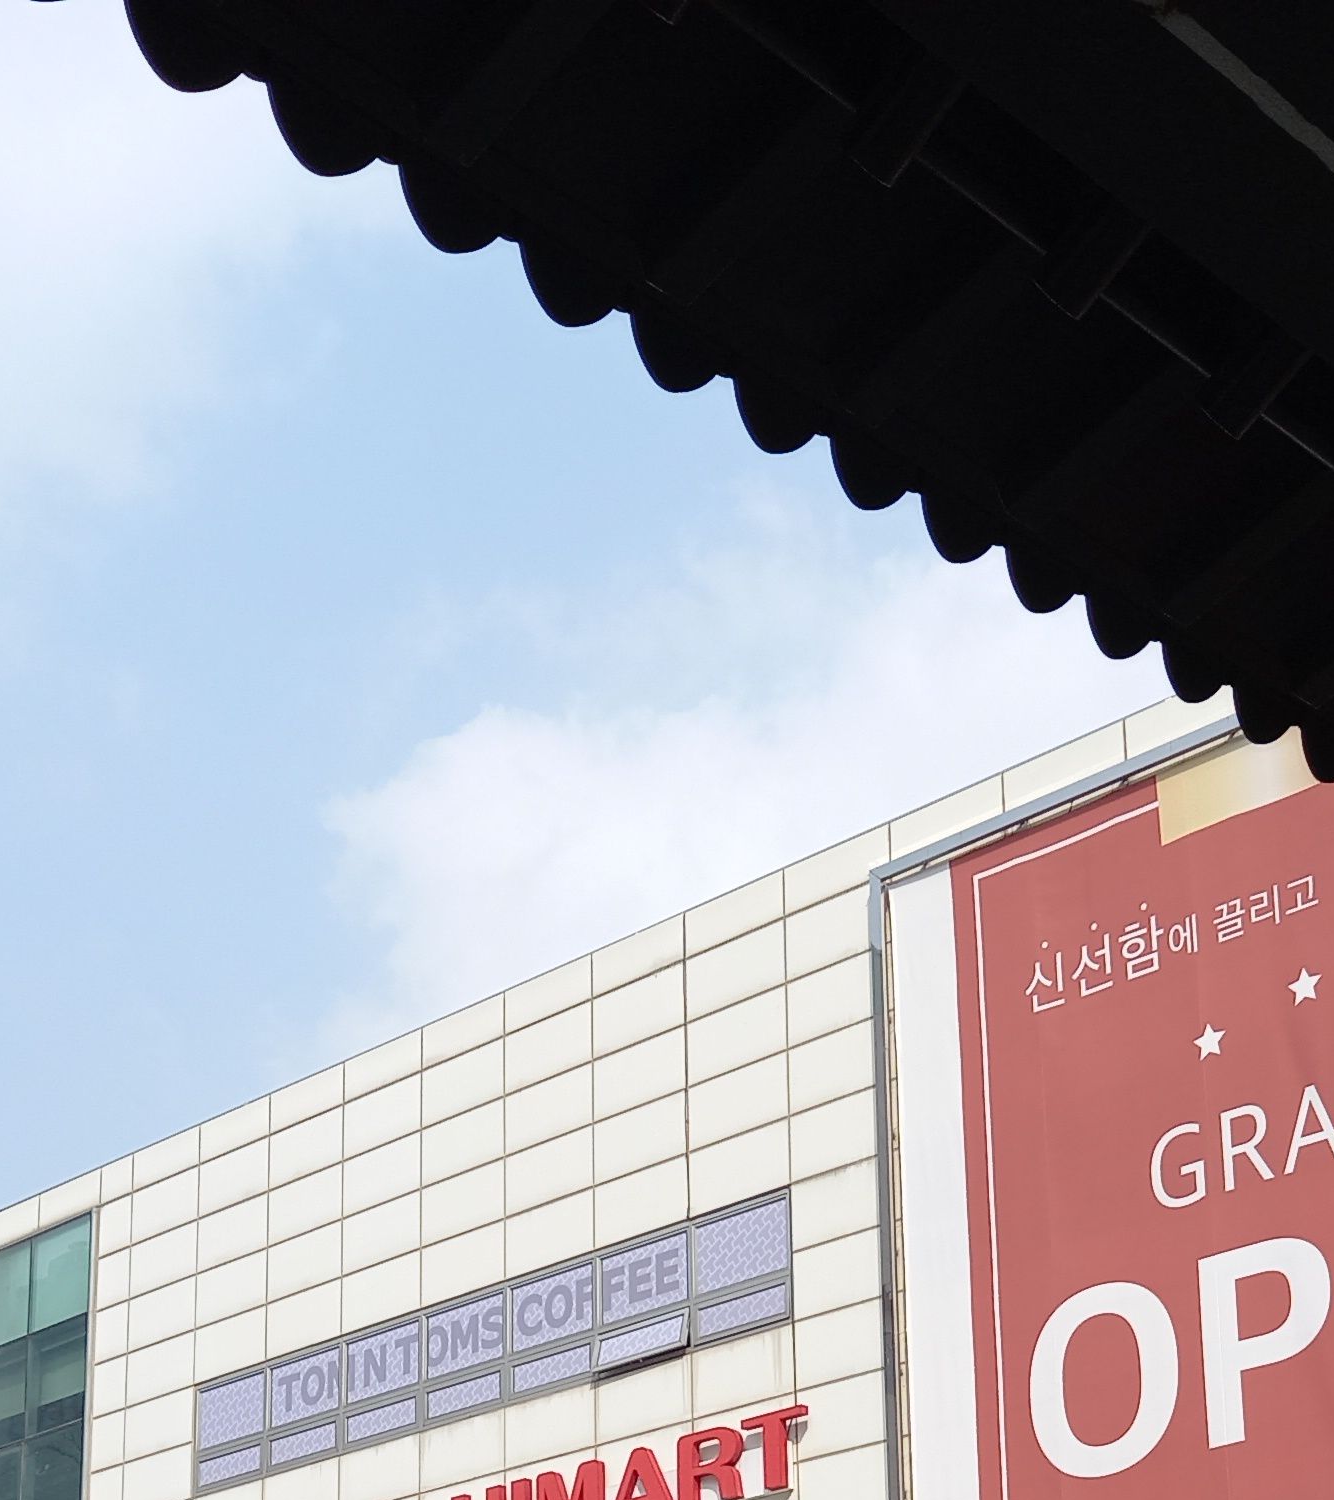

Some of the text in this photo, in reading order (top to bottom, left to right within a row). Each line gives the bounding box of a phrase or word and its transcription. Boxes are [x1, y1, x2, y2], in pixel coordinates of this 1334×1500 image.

[1024, 912, 1199, 1013] 신선함에
[1212, 875, 1320, 944] 끌리고
[394, 1306, 505, 1377] TOMS
[515, 1247, 680, 1338] COFFEE
